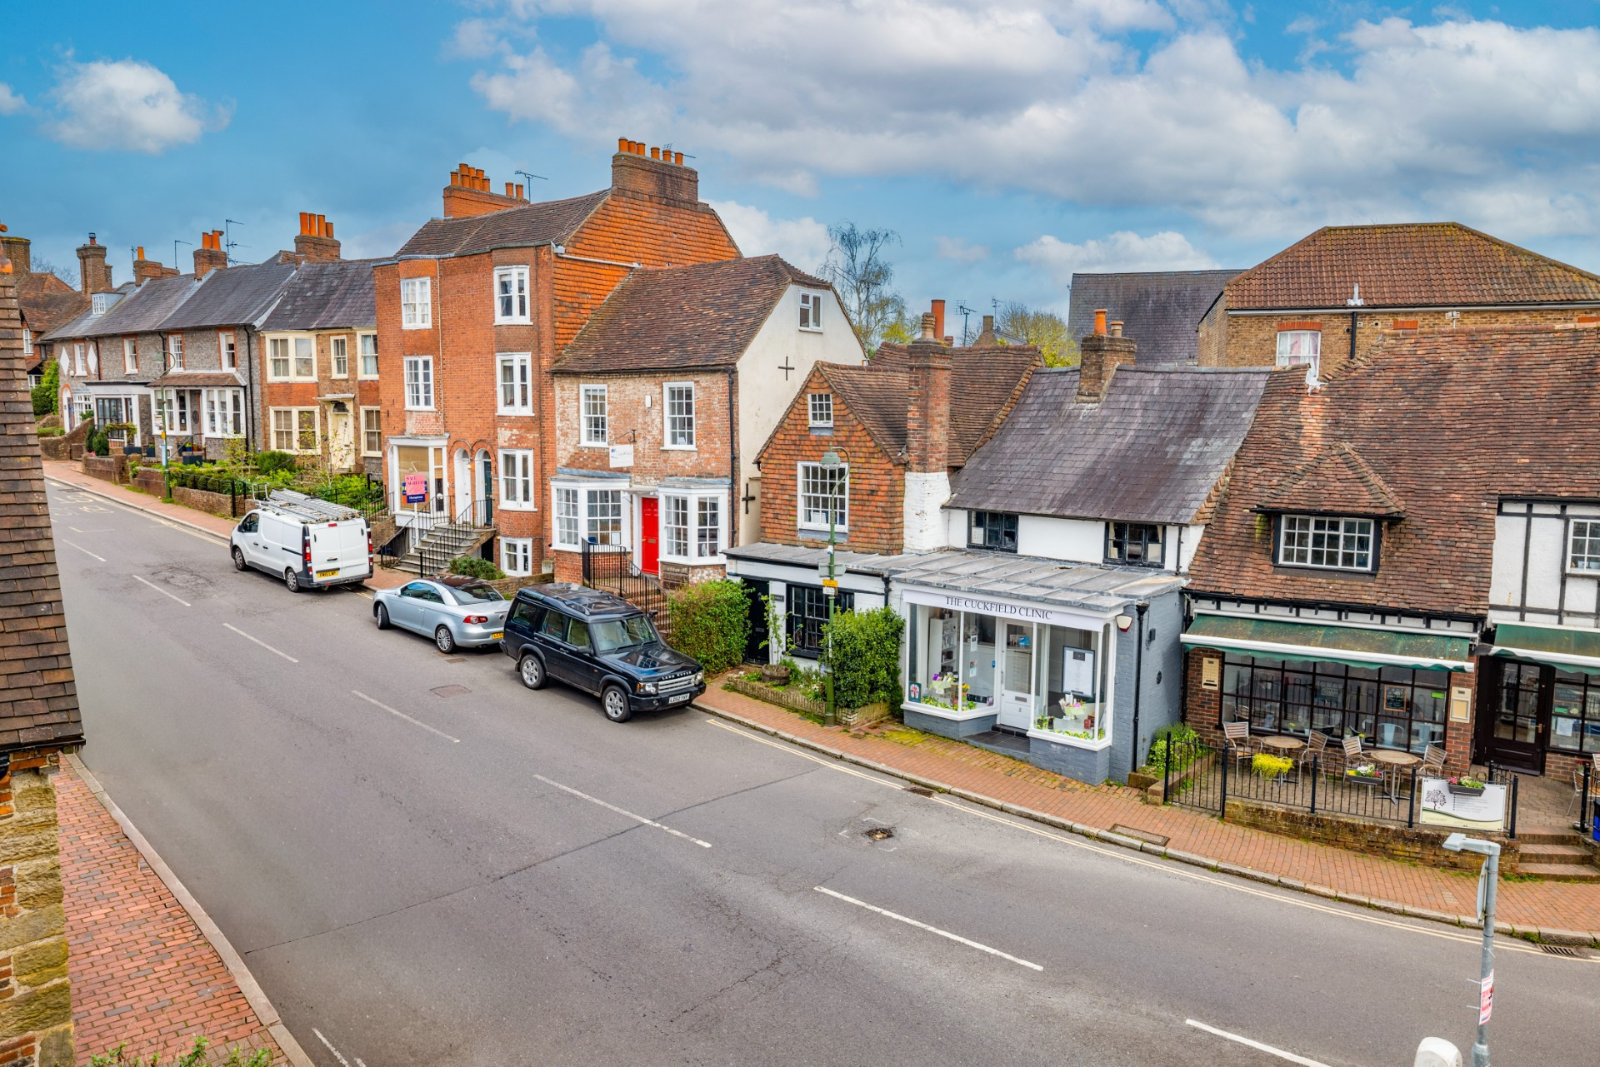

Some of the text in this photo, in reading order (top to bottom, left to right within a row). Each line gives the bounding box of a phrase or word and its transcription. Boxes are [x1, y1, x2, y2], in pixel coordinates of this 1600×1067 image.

[946, 596, 1053, 620] THE CUCKFIELD CLINIC
